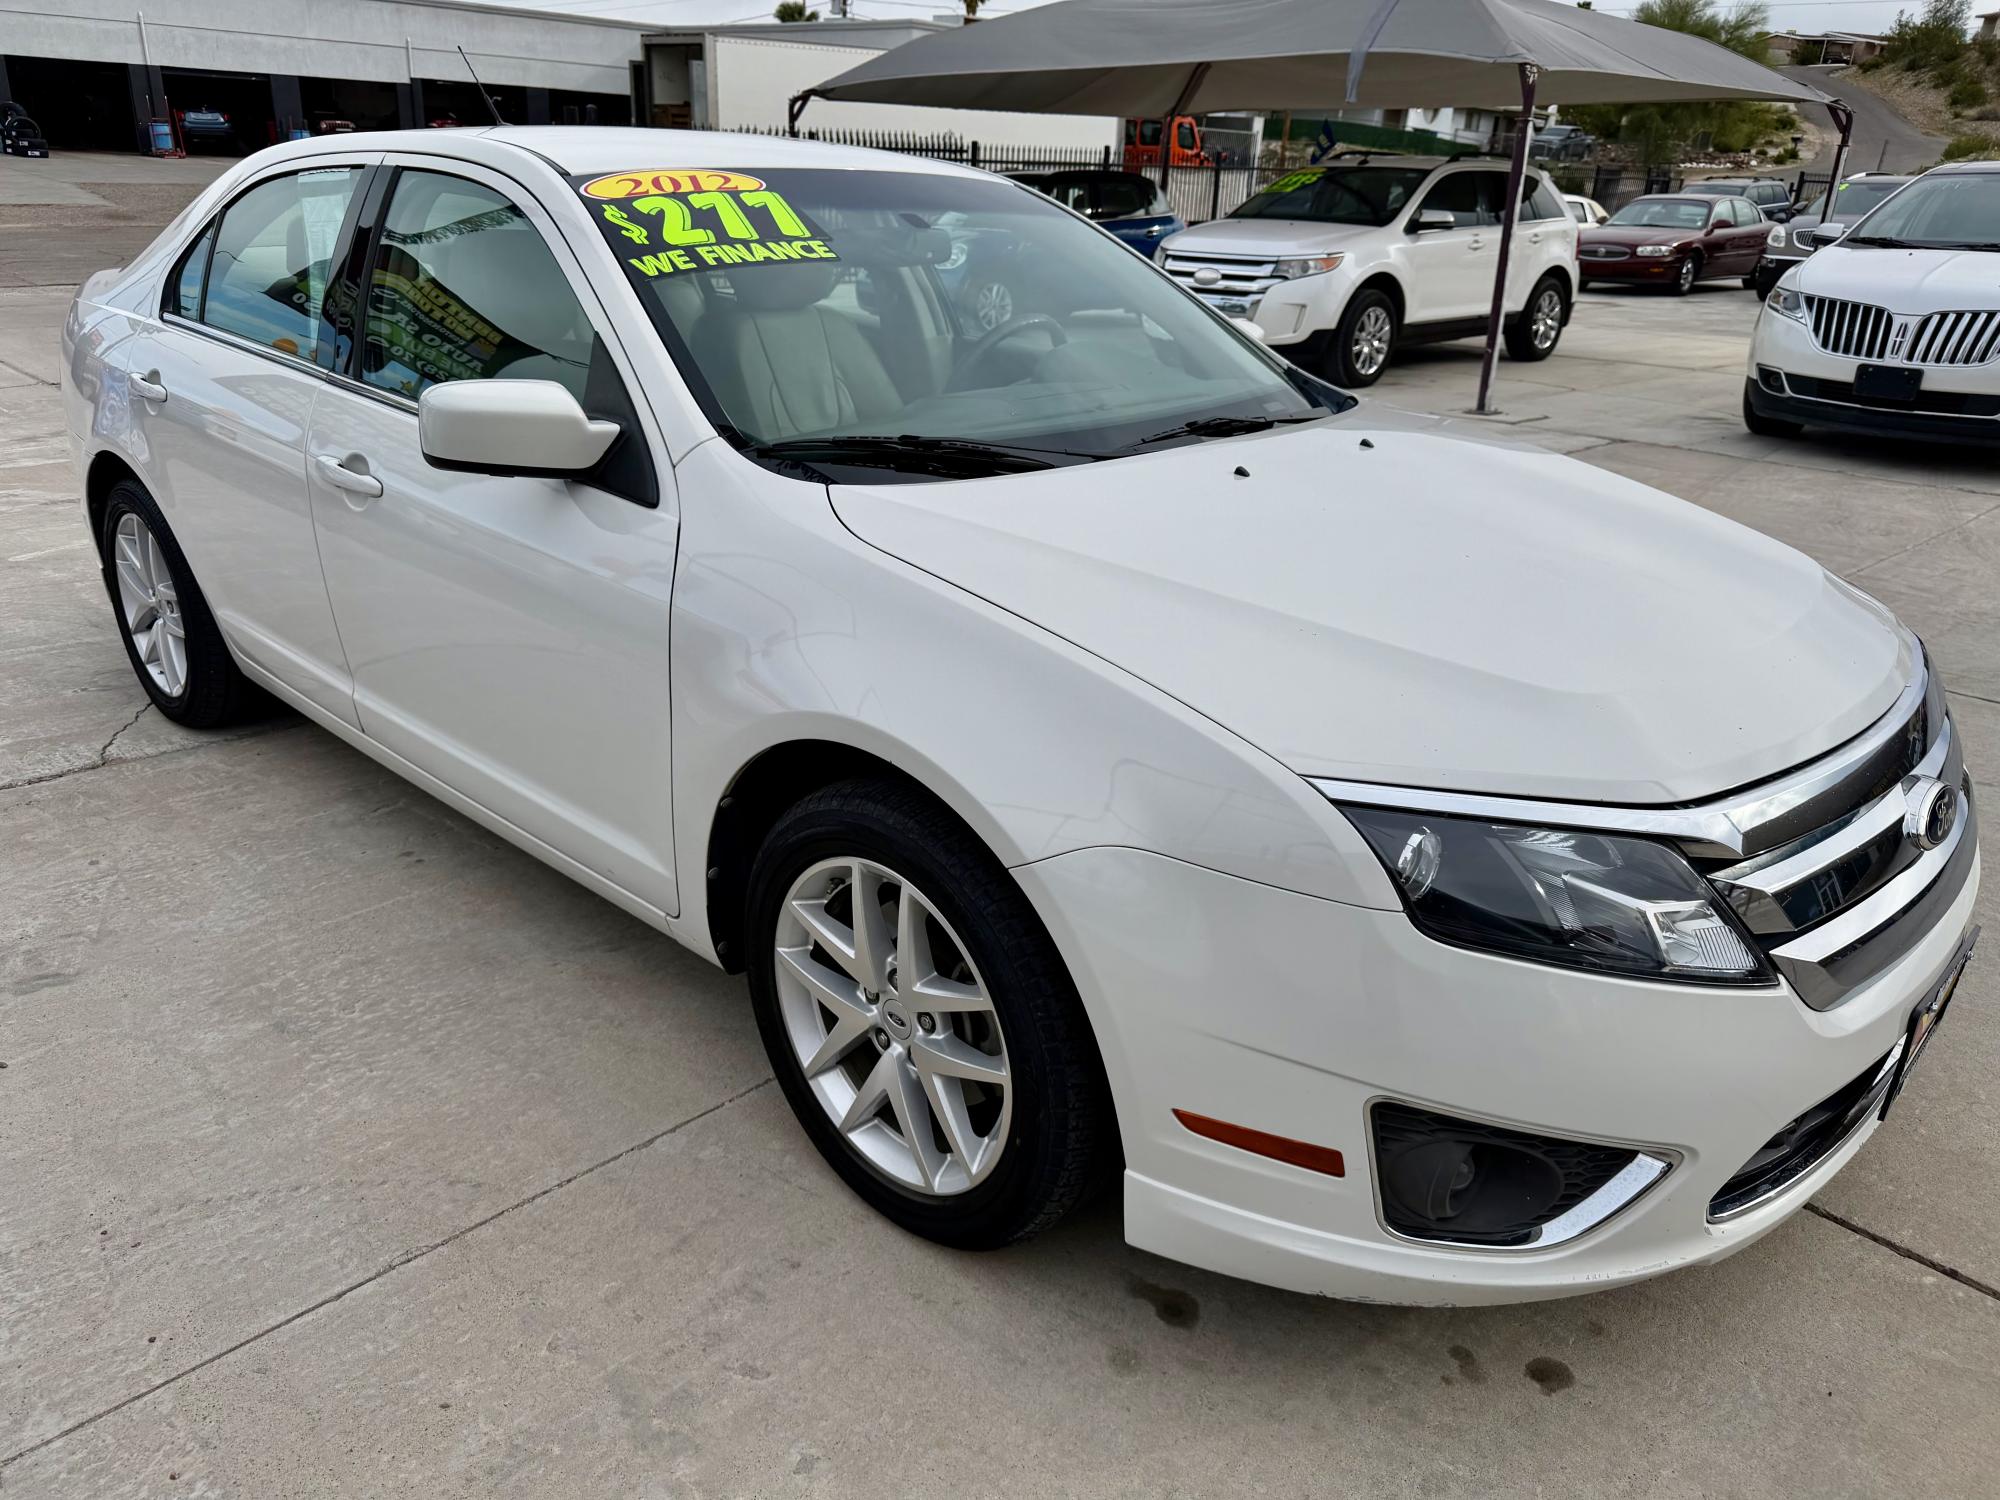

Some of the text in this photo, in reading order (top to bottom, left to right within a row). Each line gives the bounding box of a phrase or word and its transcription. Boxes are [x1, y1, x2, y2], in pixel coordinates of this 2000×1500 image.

[614, 174, 738, 196] 2012
[602, 191, 812, 246] $277
[628, 240, 838, 276] WE FINANCE
[1936, 793, 1957, 838] Ford
